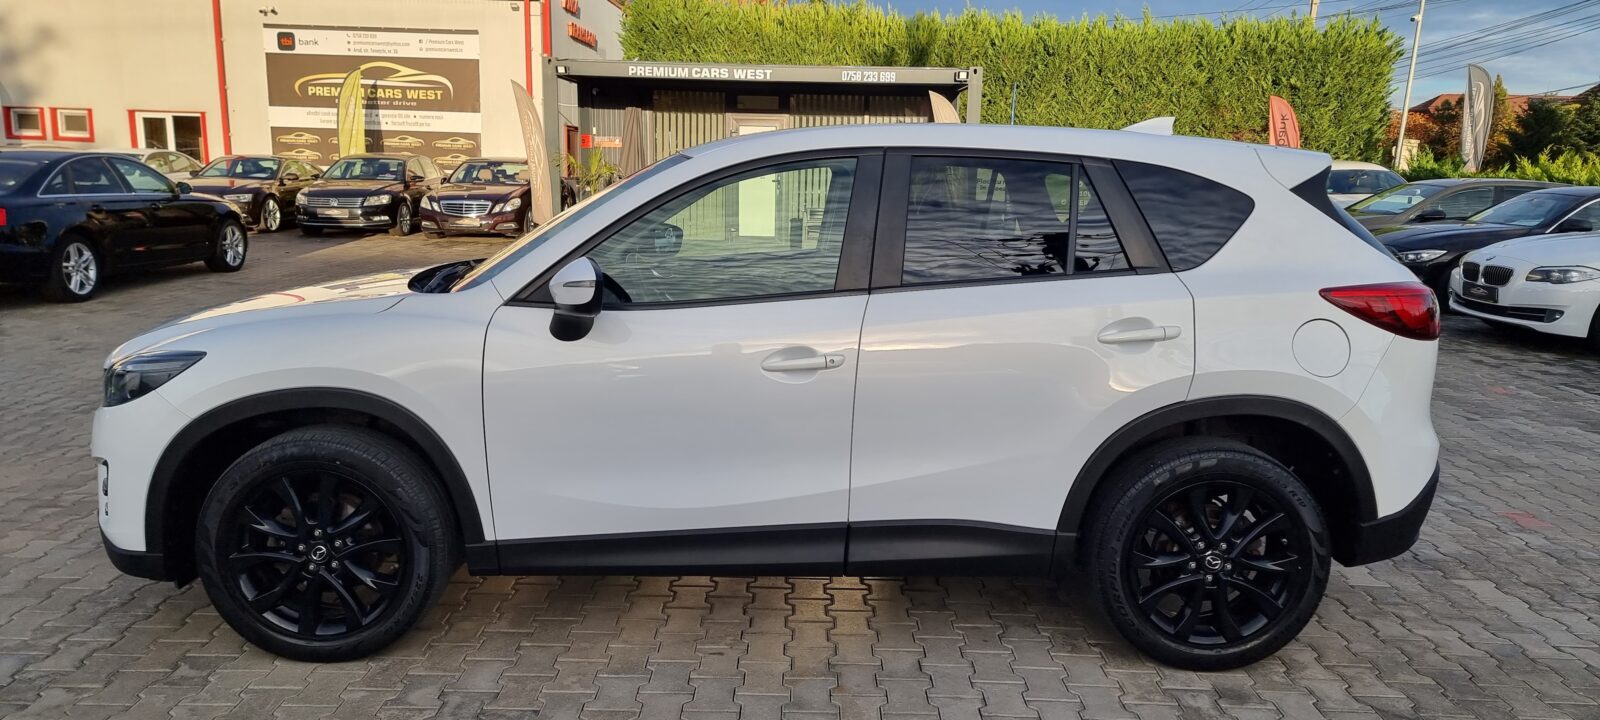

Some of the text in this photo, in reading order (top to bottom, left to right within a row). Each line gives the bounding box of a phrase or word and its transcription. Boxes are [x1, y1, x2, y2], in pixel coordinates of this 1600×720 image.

[298, 37, 319, 46] bank
[628, 65, 773, 80] PREMIUM CARS WEST
[841, 70, 896, 82] 0758 233 699
[367, 88, 402, 99] CARS
[405, 89, 443, 100] WEST
